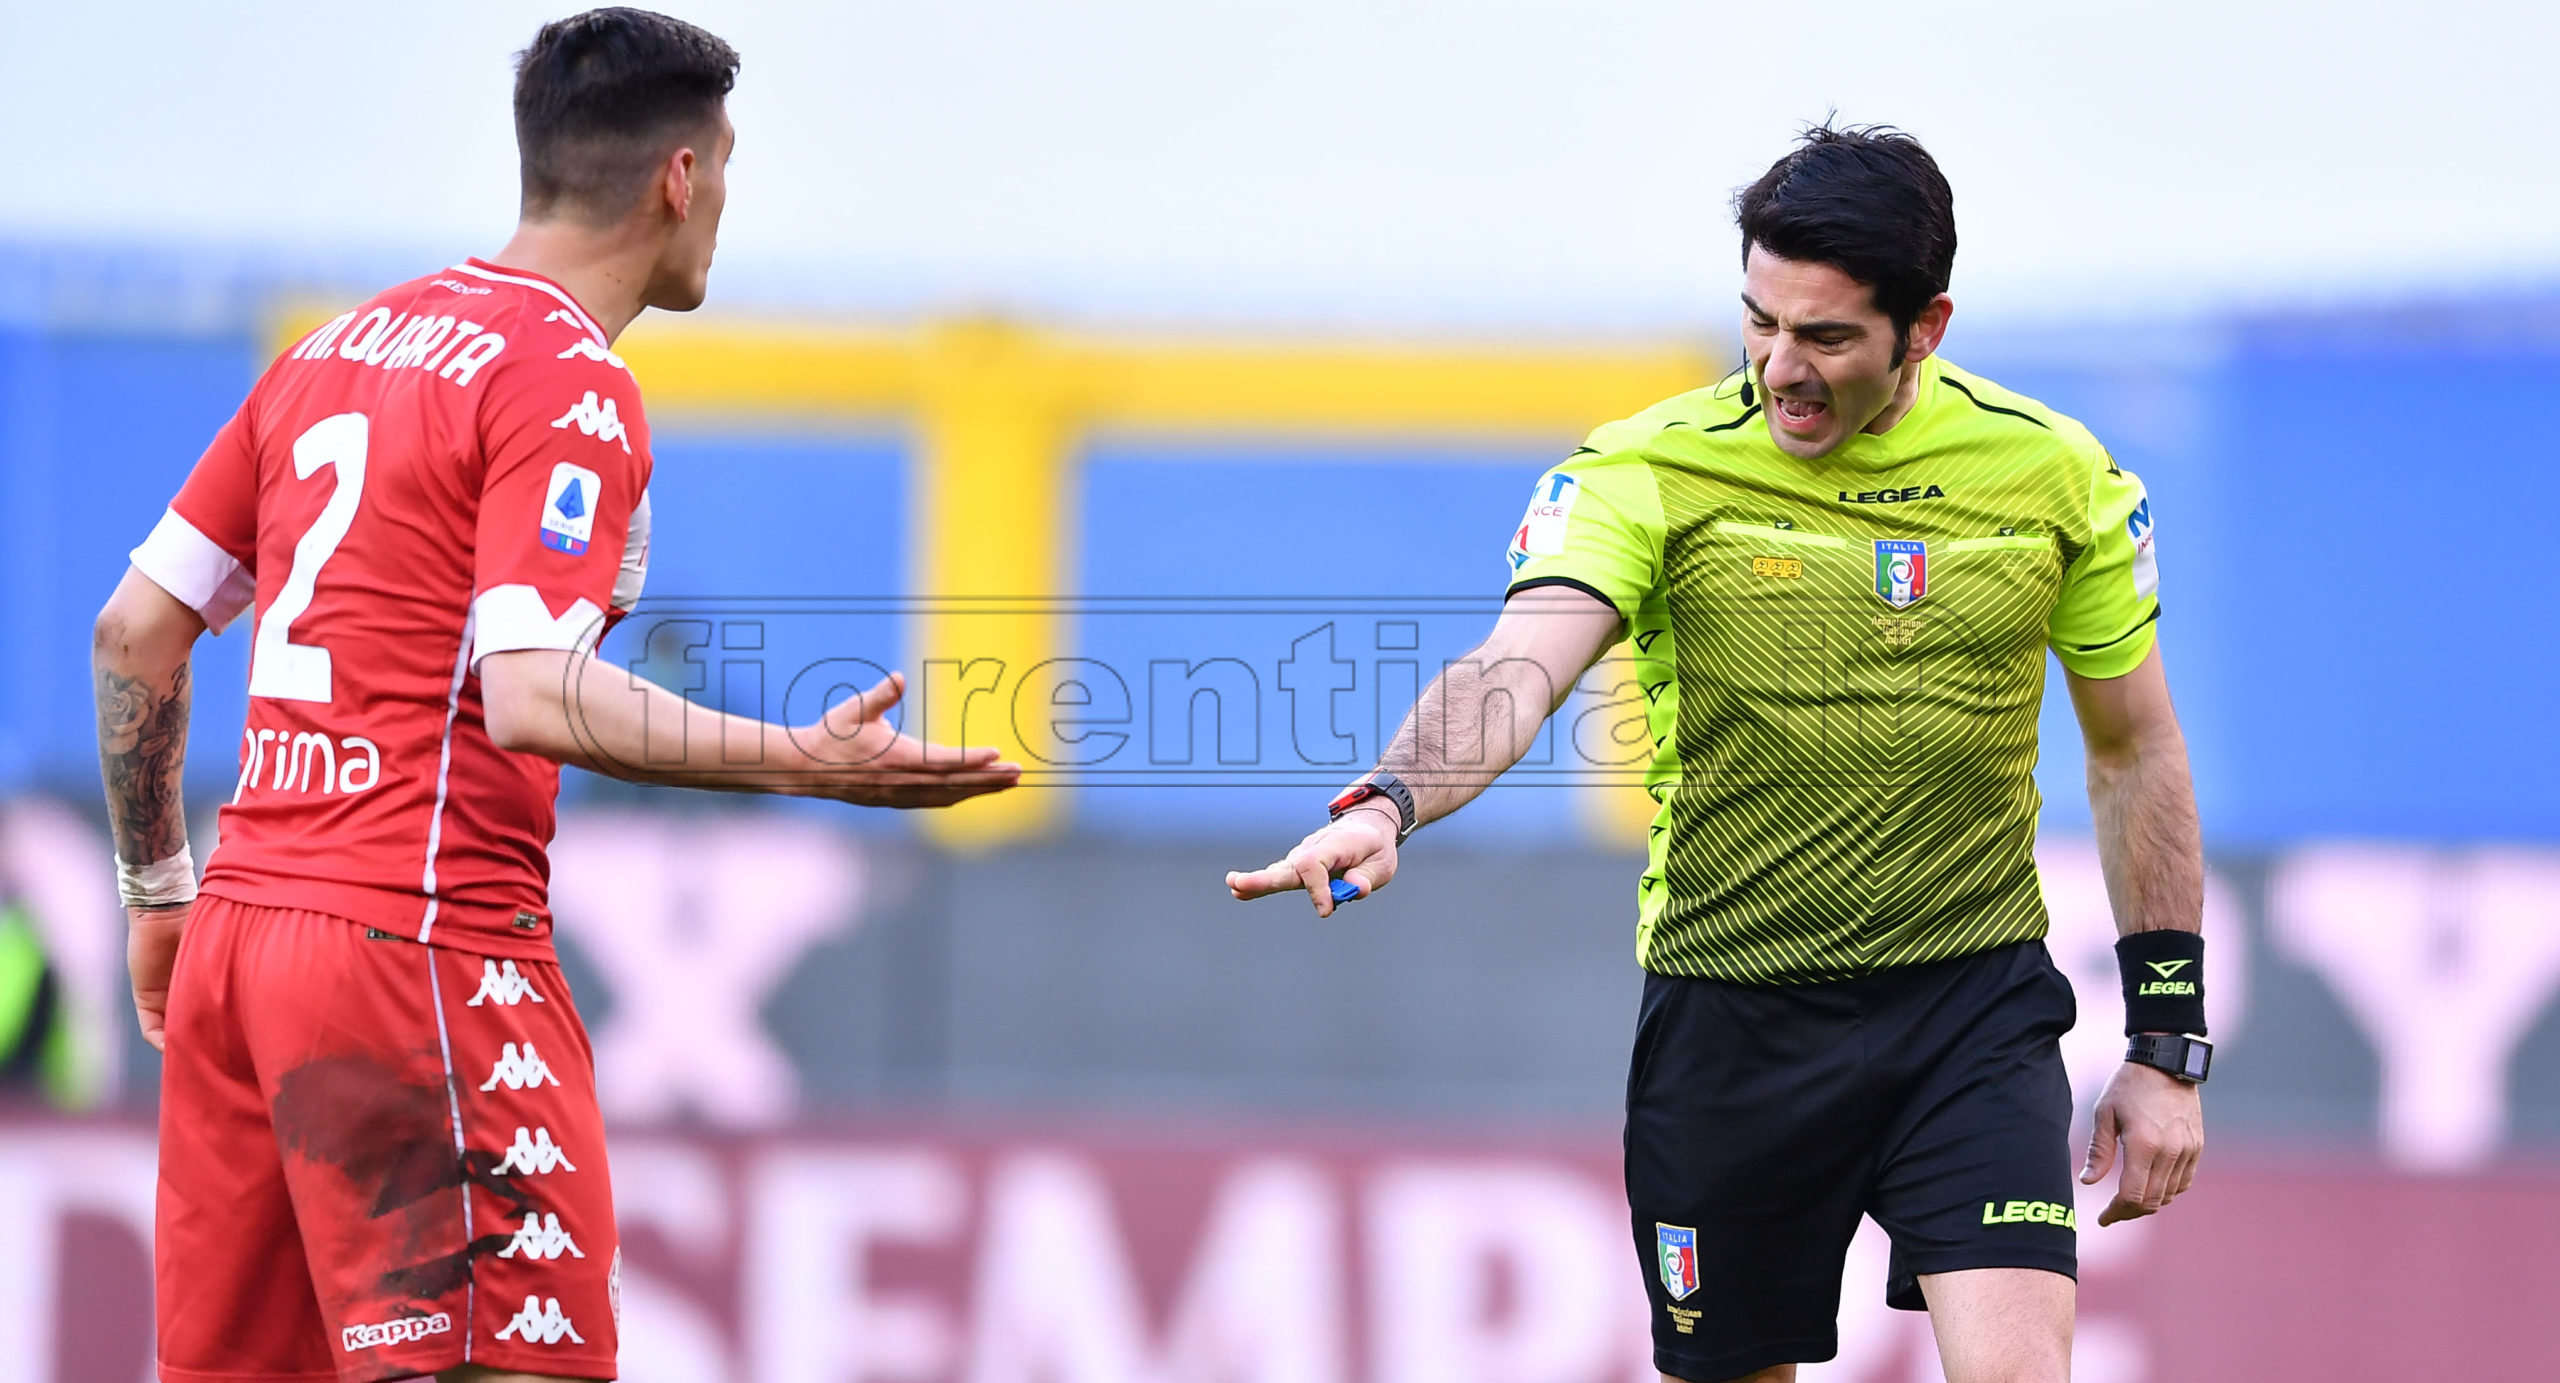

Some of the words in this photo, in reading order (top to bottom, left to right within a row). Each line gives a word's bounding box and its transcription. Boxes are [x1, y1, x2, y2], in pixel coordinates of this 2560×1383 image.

[1838, 484, 1946, 504] LEGEA
[248, 411, 369, 703] 2
[1881, 542, 1919, 552] ITALIA
[2138, 981, 2196, 996] LEGEA
[1982, 1200, 2077, 1233] LEGEA
[1661, 1231, 1688, 1244] ITALIA
[342, 1312, 452, 1352] Kappa
